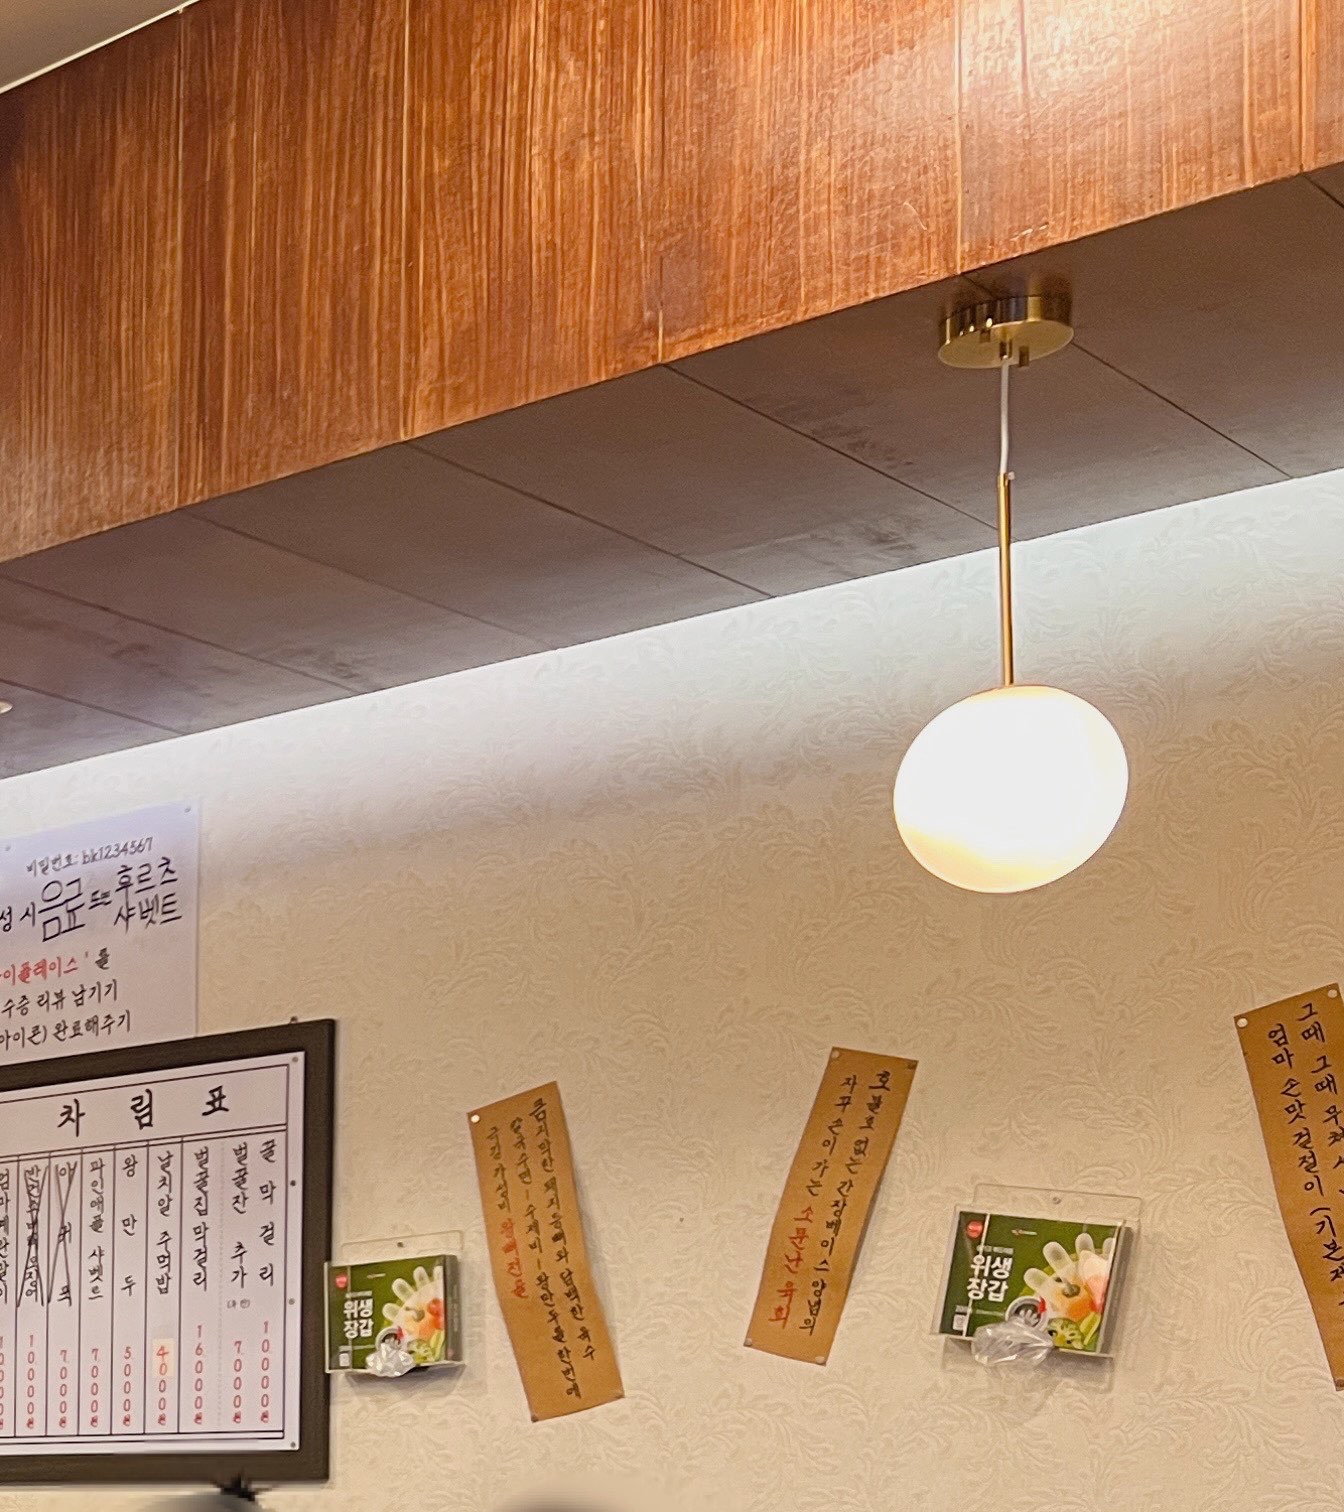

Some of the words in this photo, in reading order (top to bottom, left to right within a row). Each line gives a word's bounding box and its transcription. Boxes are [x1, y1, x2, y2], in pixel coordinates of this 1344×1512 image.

[19, 901, 37, 927] 시
[115, 855, 178, 896] 후르츠
[113, 891, 182, 934] 샤벳트
[36, 987, 68, 1016] 리뷰
[70, 978, 119, 1009] 남기기
[51, 1009, 133, 1043] 완료해주기
[1296, 1001, 1326, 1045] 그때
[1267, 1022, 1297, 1071] 엄마
[834, 1074, 858, 1113] 자꾸
[1310, 1054, 1340, 1098] 그때
[56, 1085, 231, 1138] 차림표
[1278, 1076, 1308, 1126] 손맛
[822, 1117, 846, 1157] 손이
[845, 1138, 870, 1174] 없는
[805, 1159, 829, 1197] 가는
[783, 1204, 813, 1275] 소문난
[969, 1252, 1014, 1280] 위생
[343, 1297, 374, 1319] 위생
[768, 1279, 798, 1331] 육회
[966, 1276, 1009, 1304] 장갑
[342, 1318, 375, 1340] 장갑
